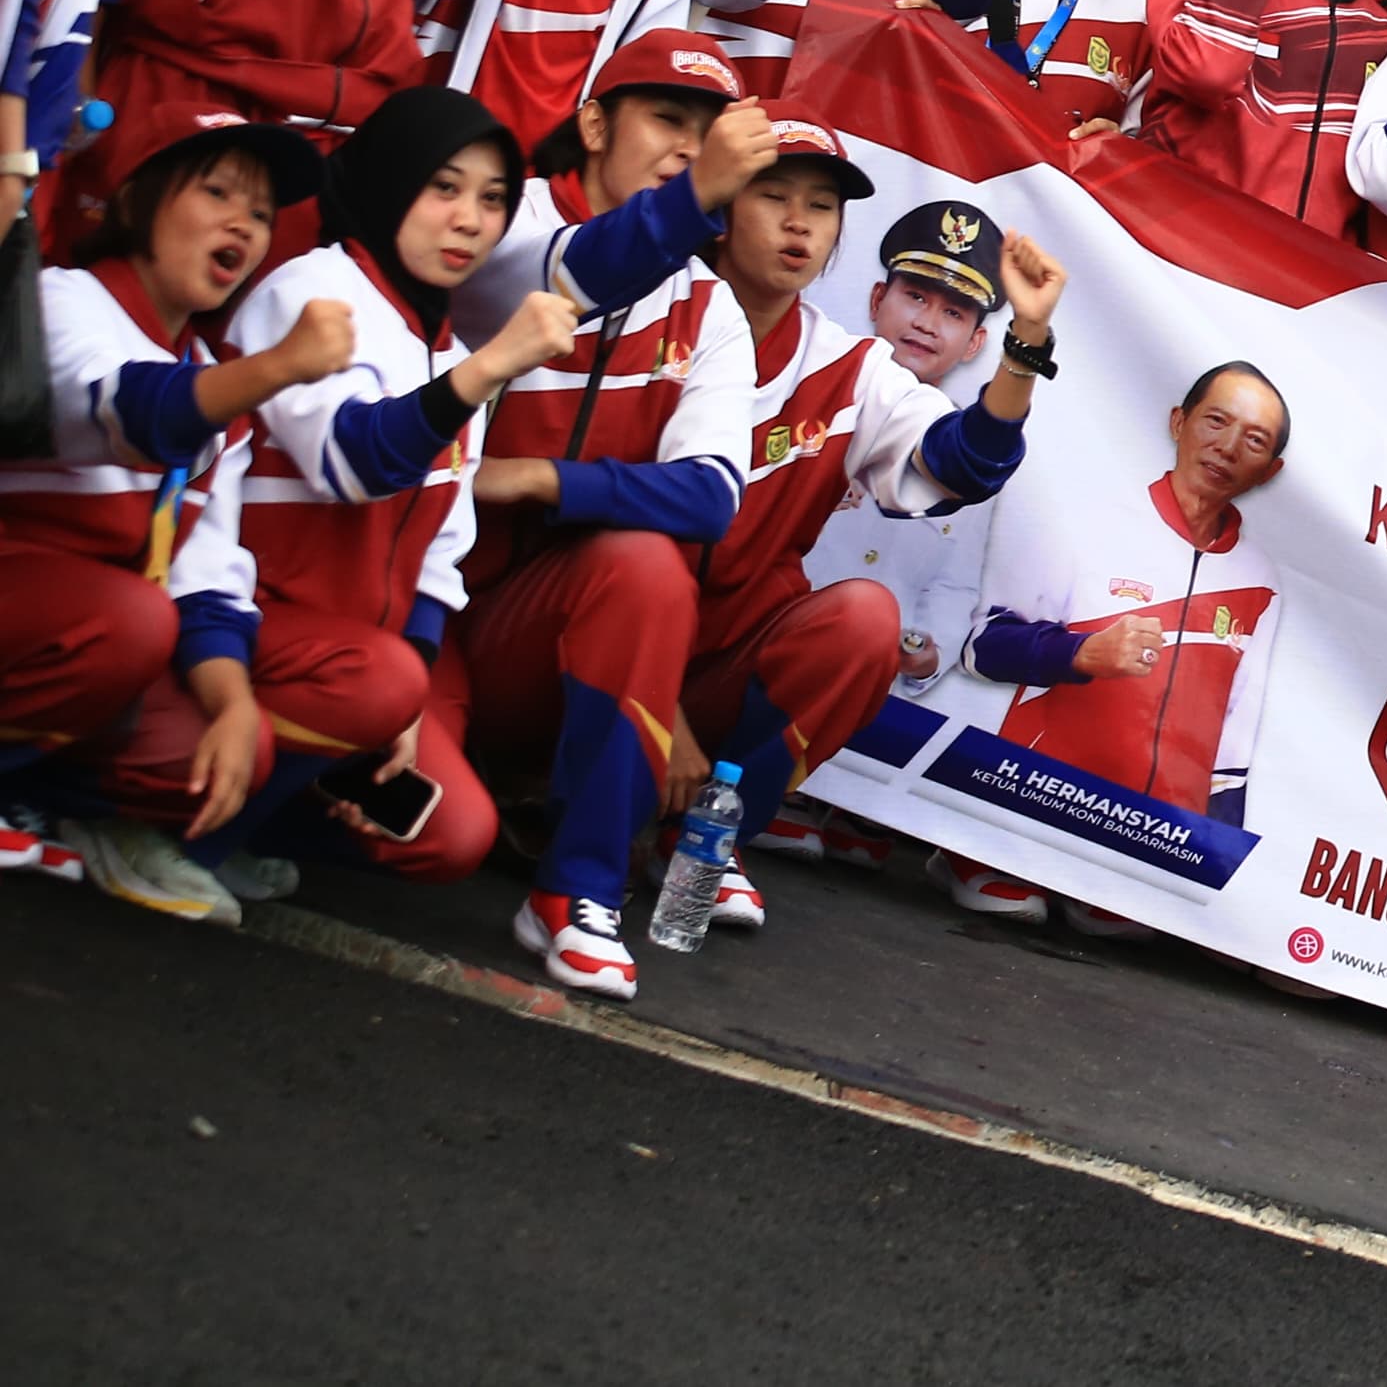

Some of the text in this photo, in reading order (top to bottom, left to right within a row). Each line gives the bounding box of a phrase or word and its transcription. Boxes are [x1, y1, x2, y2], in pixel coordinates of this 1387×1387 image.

[971, 768, 1203, 865] KETUA UMUM KONI BANJARMASIN
[997, 759, 1191, 845] H. HERMANSYAH
